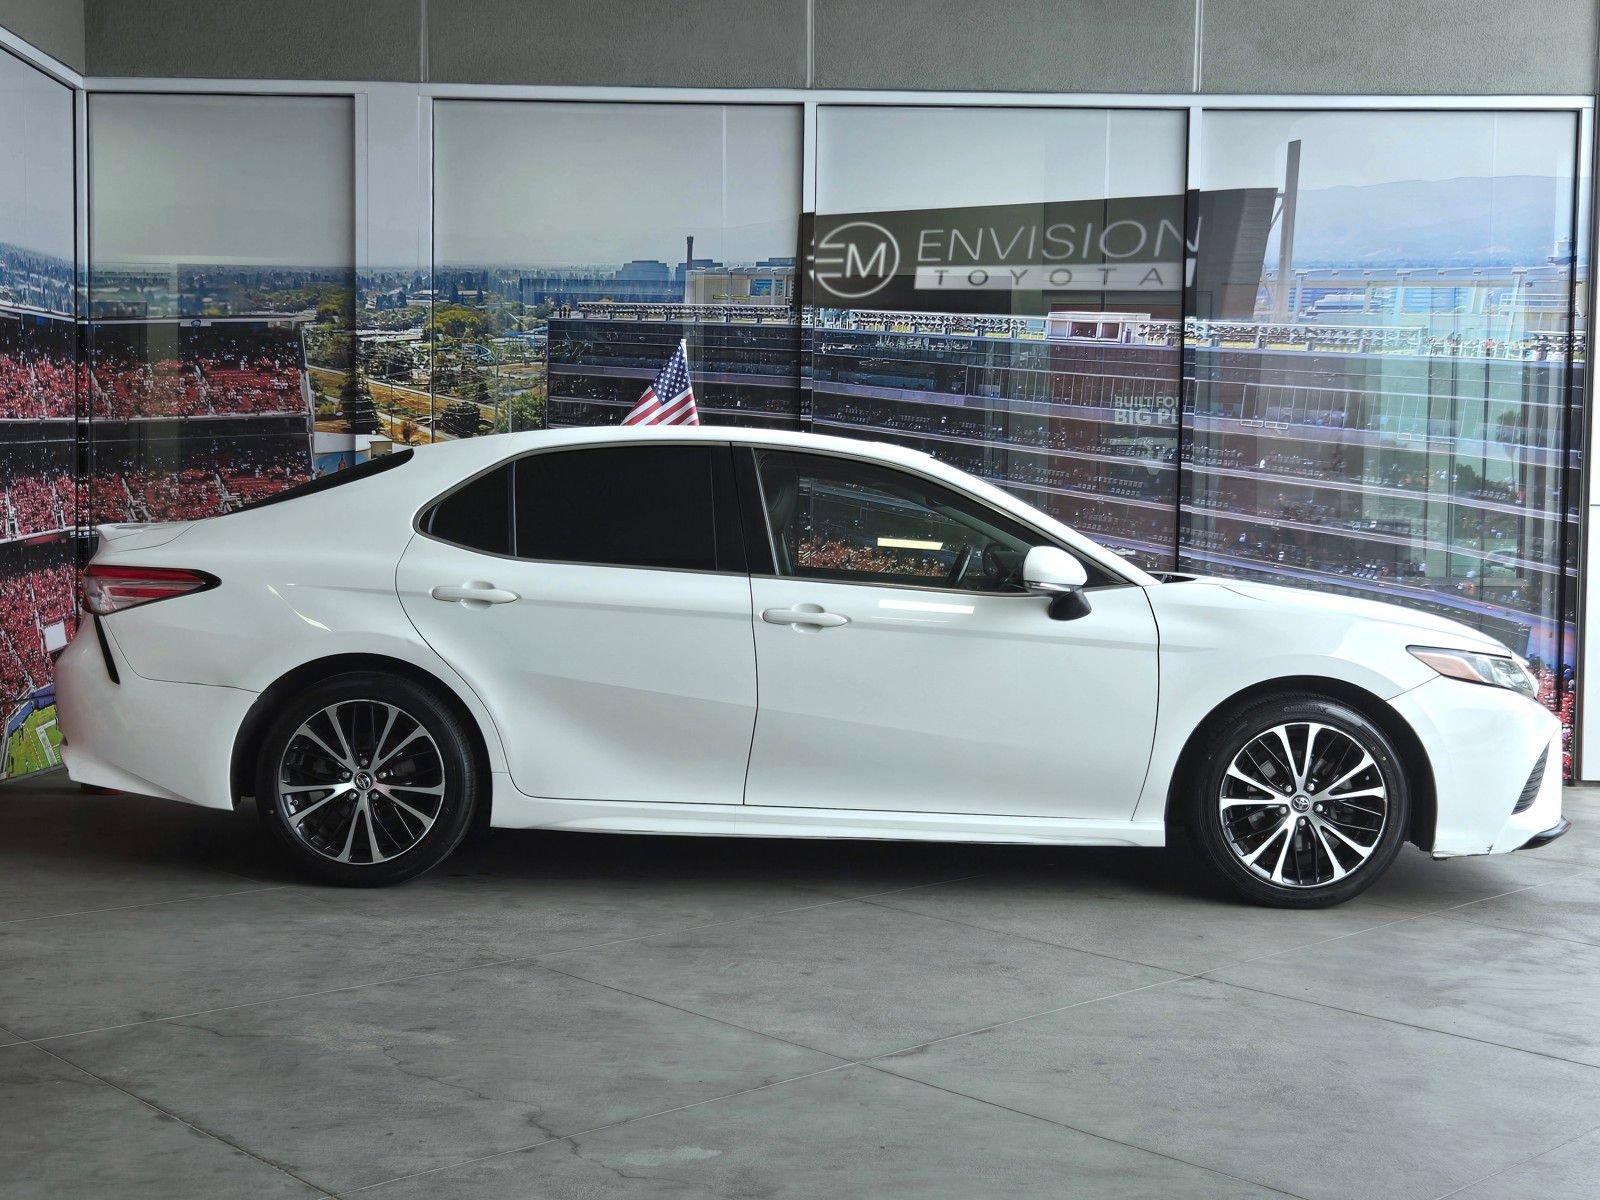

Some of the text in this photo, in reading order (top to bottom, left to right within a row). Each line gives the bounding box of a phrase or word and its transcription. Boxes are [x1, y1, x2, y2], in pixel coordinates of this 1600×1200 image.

[917, 216, 1202, 262] ENVISION
[934, 267, 1164, 287] TOYOTA
[1114, 396, 1153, 408] BUILT
[1114, 408, 1152, 425] BIG
